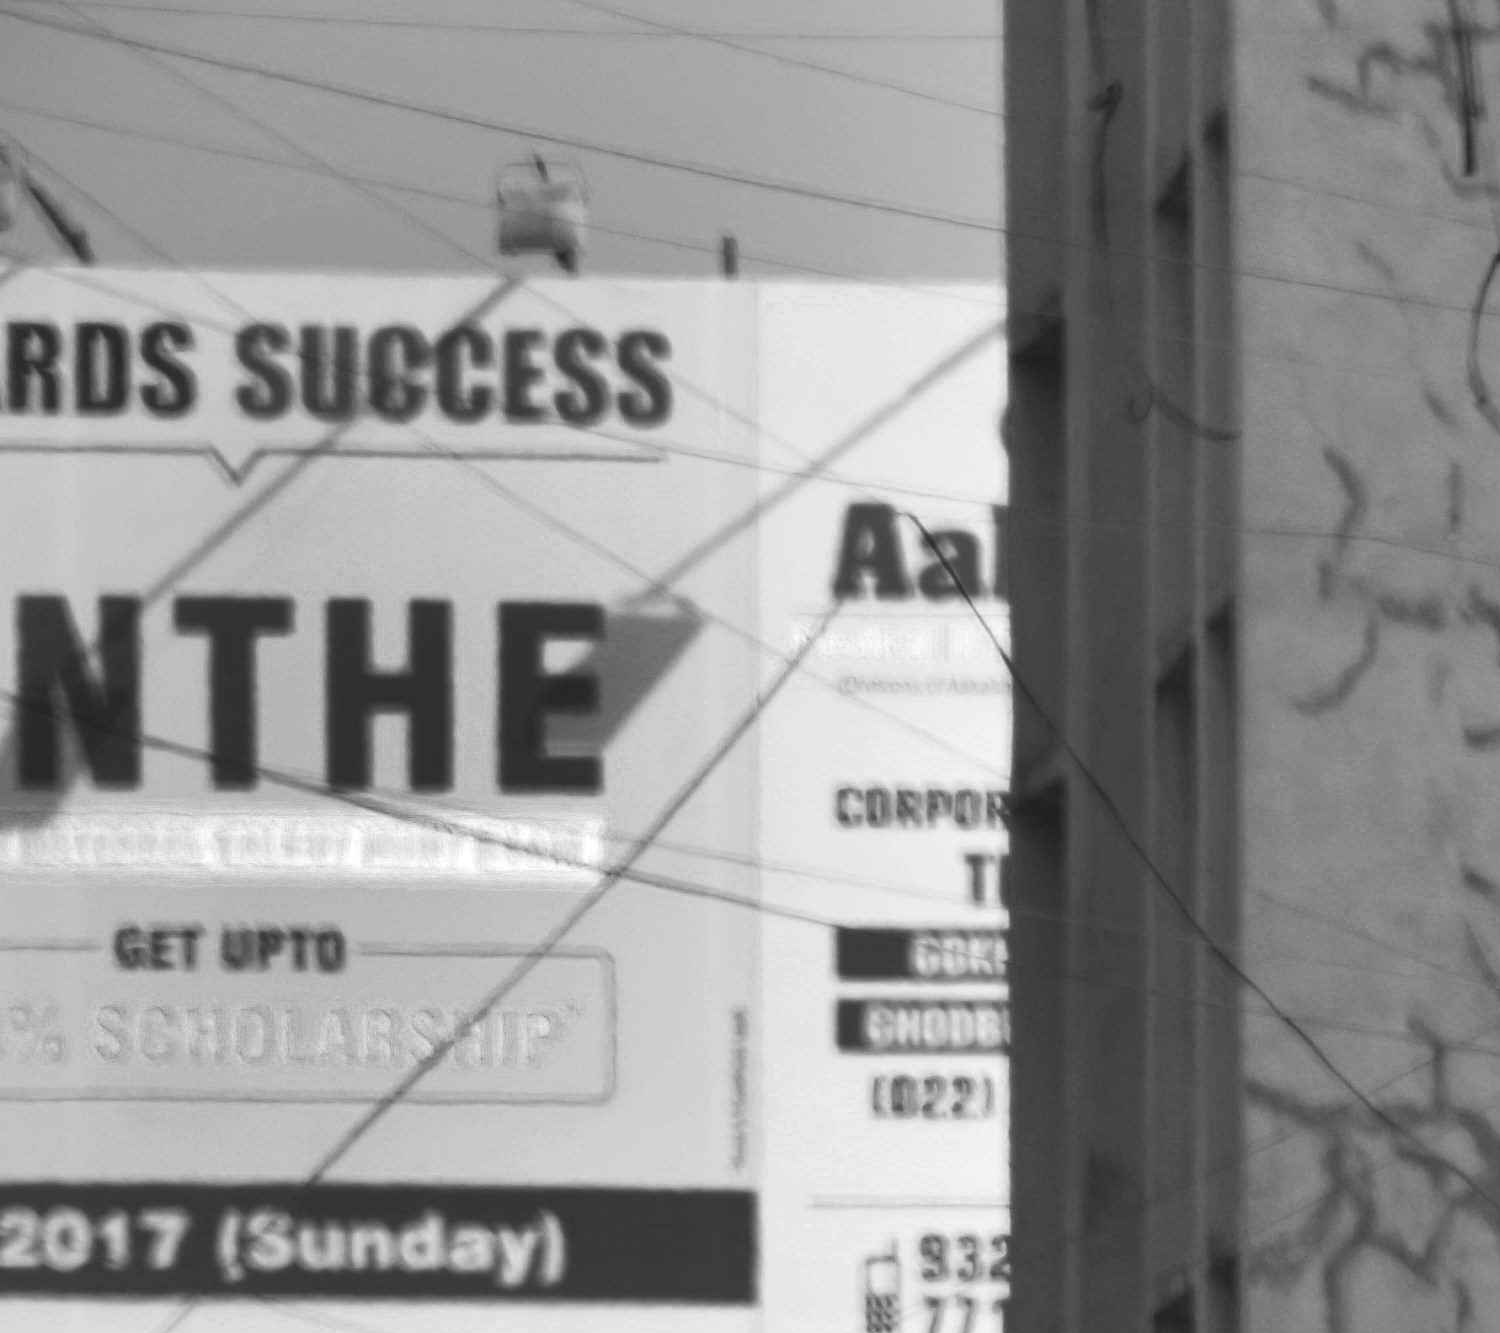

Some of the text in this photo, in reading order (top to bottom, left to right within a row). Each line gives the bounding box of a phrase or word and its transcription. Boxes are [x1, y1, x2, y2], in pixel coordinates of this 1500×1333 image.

[0, 319, 676, 429] RDS SUCCESS
[832, 502, 1009, 602] Aa
[114, 924, 347, 974] GET UPTO
[872, 1074, 996, 1121] (022)
[0, 1211, 567, 1286] 2017 (Sunday)
